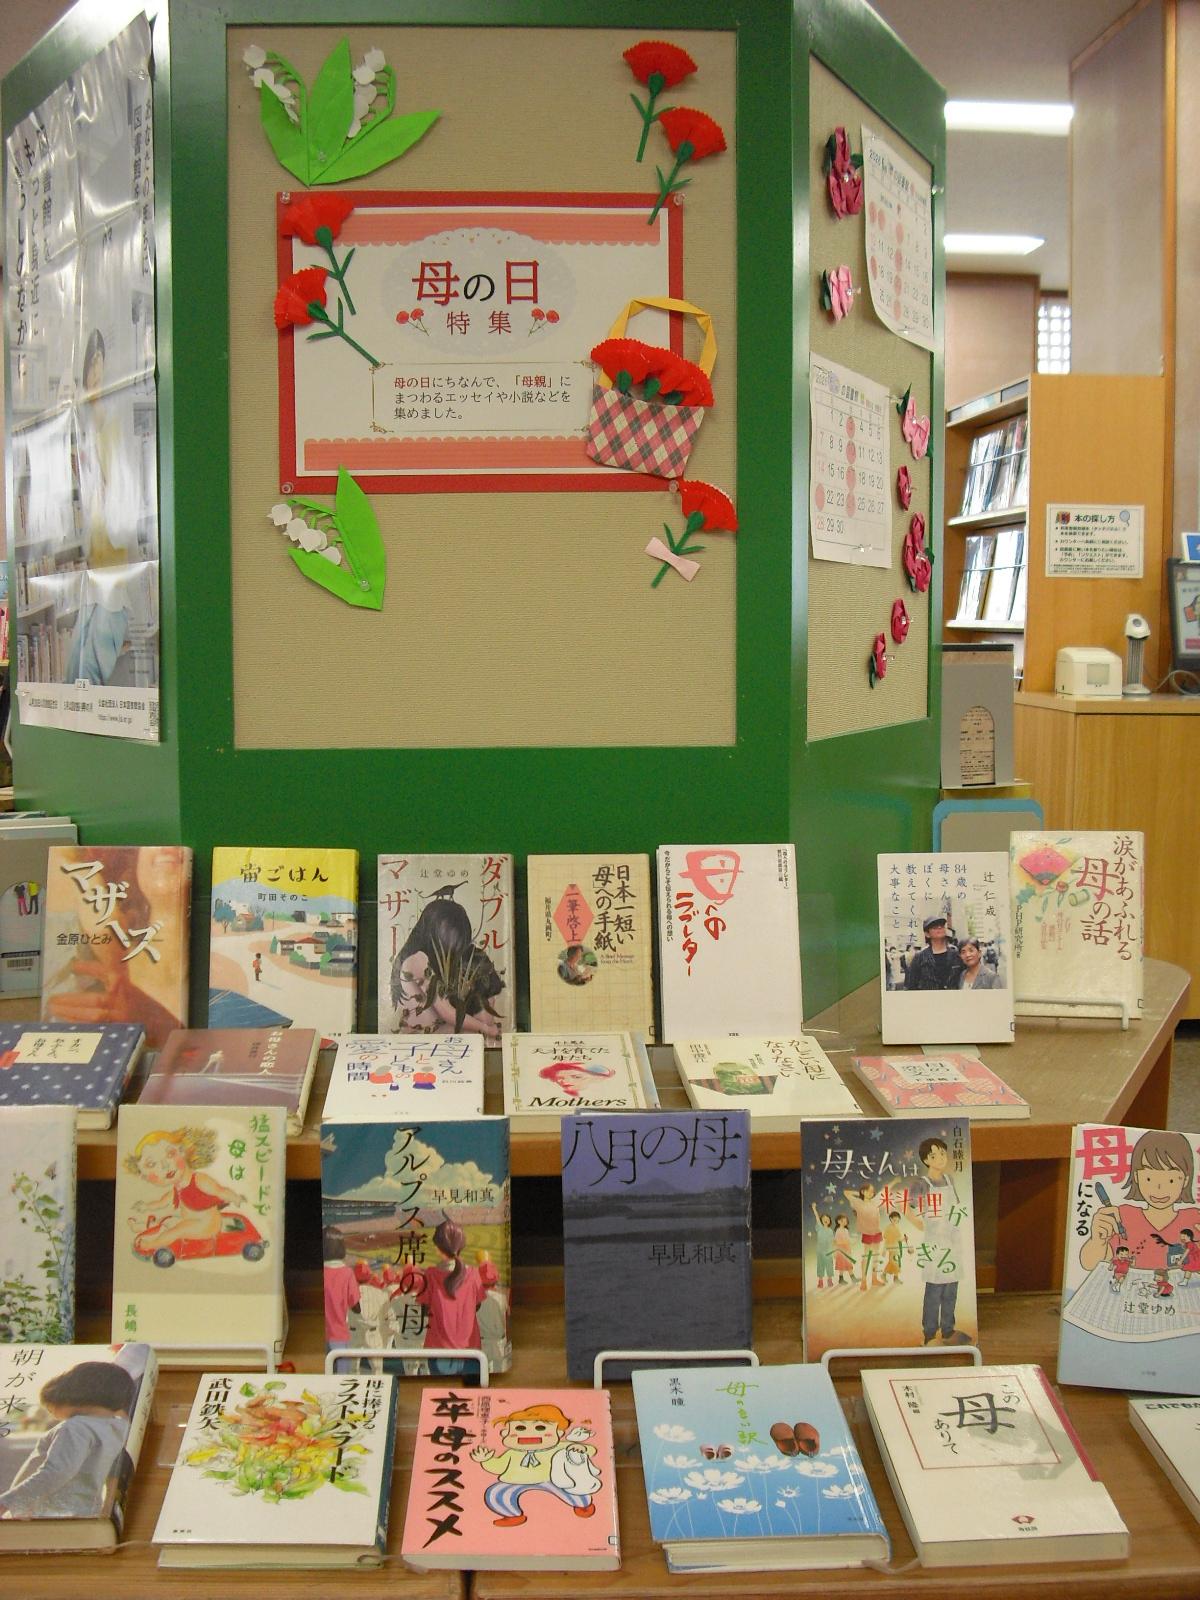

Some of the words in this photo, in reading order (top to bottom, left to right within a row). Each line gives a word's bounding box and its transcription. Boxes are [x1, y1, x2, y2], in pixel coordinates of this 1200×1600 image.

[412, 260, 540, 306] 母の日
[446, 310, 512, 336] 特集
[394, 375, 571, 390] 母の日にちなんで、「母親」に
[394, 391, 571, 405] まつわるエッセイや小説などを
[394, 407, 464, 420] 集めました。
[1074, 513, 1116, 524] 本の探し方
[240, 863, 329, 884] 宙ごはん
[419, 869, 469, 879] 辻堂ゆめ
[890, 864, 901, 929] 大事なこと
[923, 863, 933, 900] ぼくに
[939, 863, 950, 914] 母さんが
[954, 863, 967, 901] 84歳の
[984, 871, 997, 917] 辻仁成
[61, 860, 165, 963] マザーズ
[257, 893, 308, 901] 町田そのこ
[380, 859, 411, 956] マザー
[480, 856, 508, 950] ダブル
[565, 891, 582, 943] 一筆啓上
[592, 864, 617, 953] 「母」への手紙
[614, 864, 637, 945] 日本一短い
[906, 863, 918, 944] 教えてくれた
[1071, 857, 1120, 945] 母の話
[1113, 835, 1137, 961] 涙があふれる
[56, 933, 112, 946] 金原ひとみ
[674, 893, 699, 976] ラブレター
[528, 1096, 627, 1108] Mothers
[228, 1139, 246, 1181] 母は
[250, 1114, 272, 1217] 猛スピードで
[563, 1117, 742, 1187] 八月の母
[821, 1148, 920, 1180] 母さんは
[952, 1125, 965, 1173] 白石睦月
[431, 1188, 496, 1204] 早見和真
[879, 1184, 968, 1228] 料理が
[393, 1125, 431, 1340] アルプス席の母
[649, 1243, 737, 1267] 早見和真
[826, 1240, 957, 1276] へたすぎる
[124, 1304, 137, 1342] 長嶋
[1123, 1300, 1176, 1317] 辻堂ゆめ
[197, 1377, 234, 1431] 武田鉄矢
[361, 1378, 385, 1431] 母に捧げる
[938, 1392, 1017, 1435] 母
[327, 1378, 360, 1484] ラストバラード
[422, 1391, 477, 1549] 卒母のススメ
